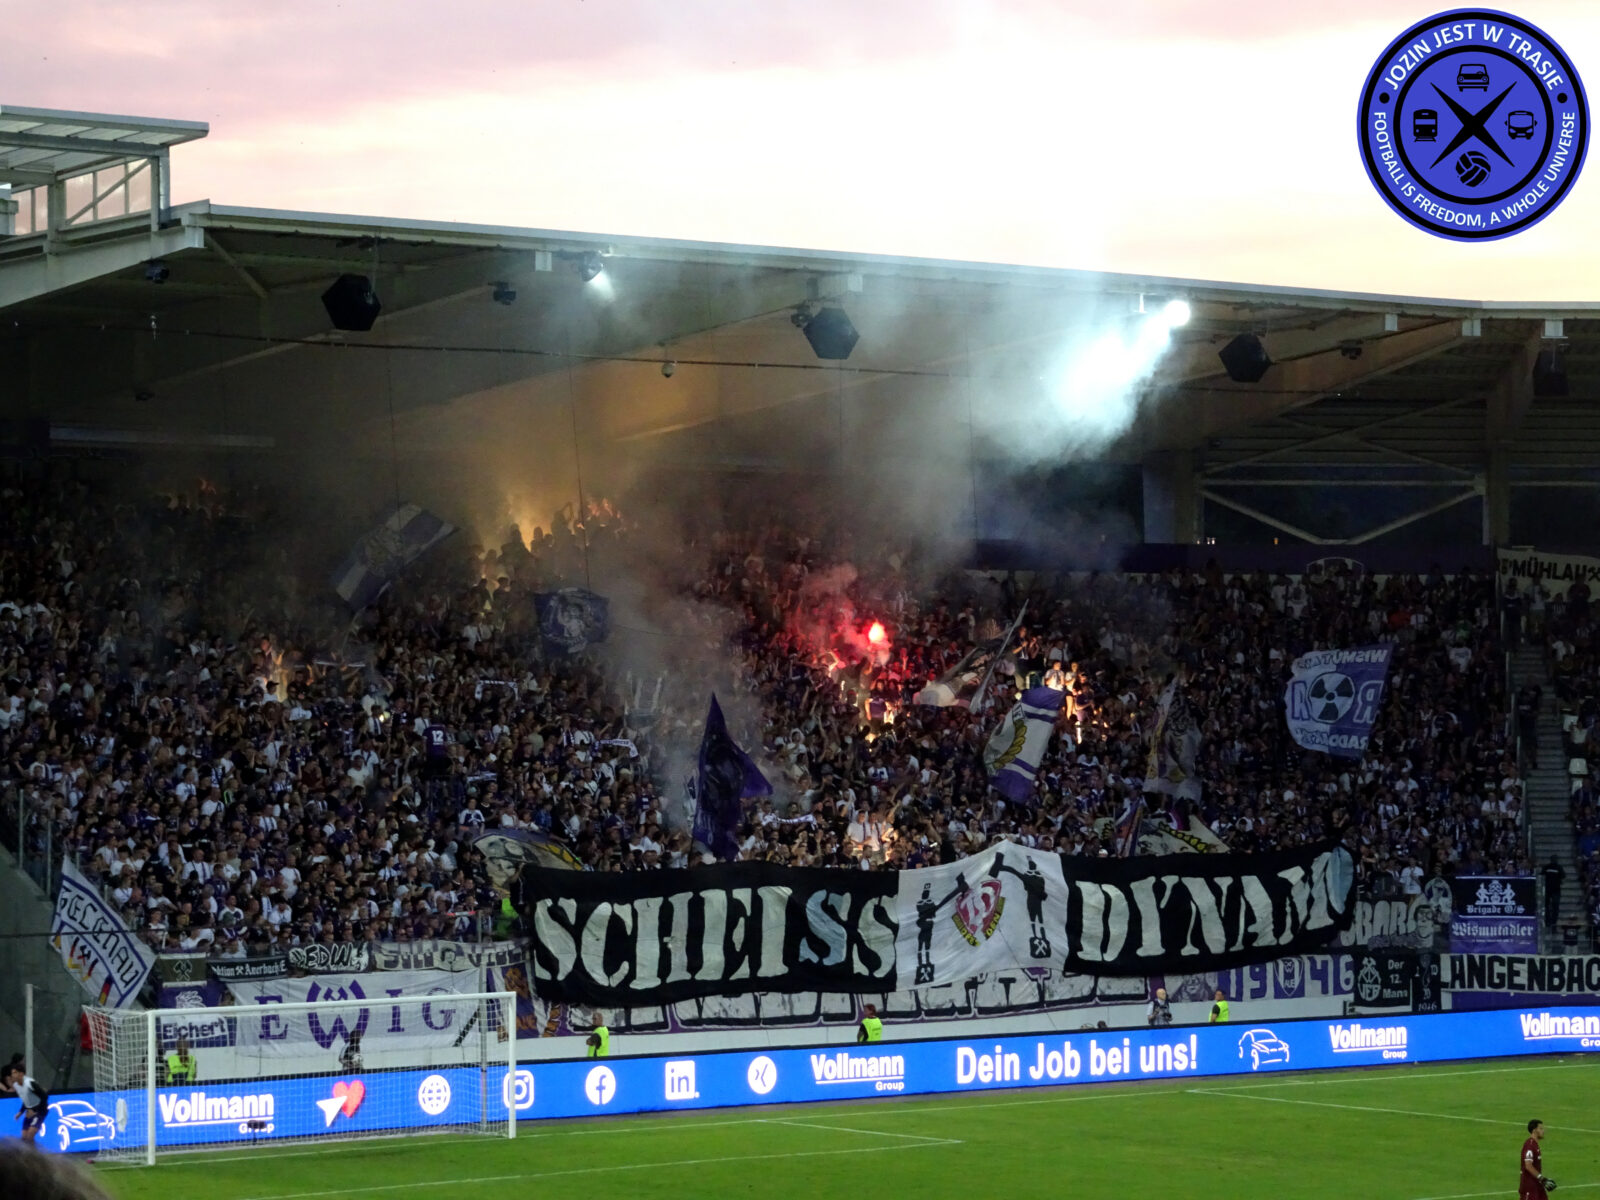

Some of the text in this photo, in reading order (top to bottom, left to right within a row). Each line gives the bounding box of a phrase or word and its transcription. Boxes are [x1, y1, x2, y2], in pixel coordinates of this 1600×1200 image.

[534, 885, 898, 991] SCHEISS
[1451, 921, 1534, 937] Wismutadler
[1440, 953, 1600, 993] LANGENBAC
[163, 1016, 226, 1040] Eichert
[1329, 1024, 1407, 1048] Vollmann
[810, 1052, 905, 1080] Vollmann
[956, 1034, 1197, 1084] Dein Job bei uns!
[1382, 1050, 1407, 1059] Group
[875, 1080, 905, 1092] Group
[159, 1093, 275, 1123] Vollmann
